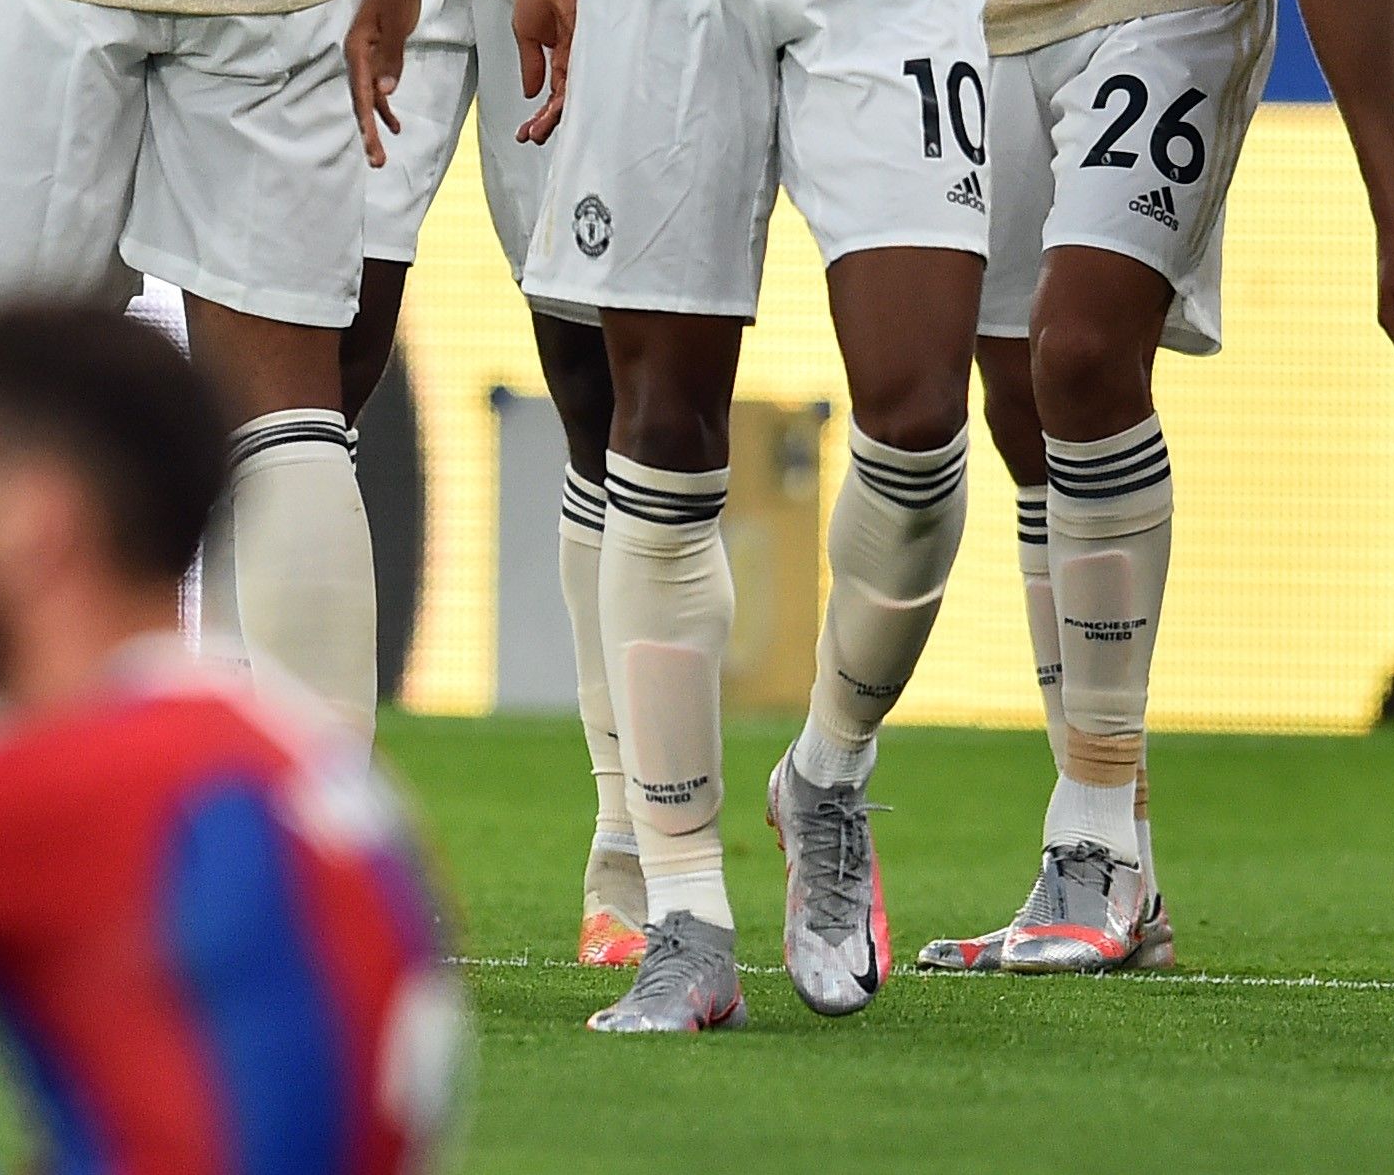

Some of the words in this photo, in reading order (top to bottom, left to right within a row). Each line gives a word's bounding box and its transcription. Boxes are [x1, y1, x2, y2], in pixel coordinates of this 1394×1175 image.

[903, 57, 986, 166] 10
[1079, 73, 1208, 185] 26
[946, 190, 986, 215] adida
[1128, 200, 1180, 232] adidas
[1064, 617, 1147, 631] MANCHESTER
[1084, 630, 1132, 641] UNITED
[633, 775, 708, 793] NCHESTER
[645, 792, 691, 804] UNITED
